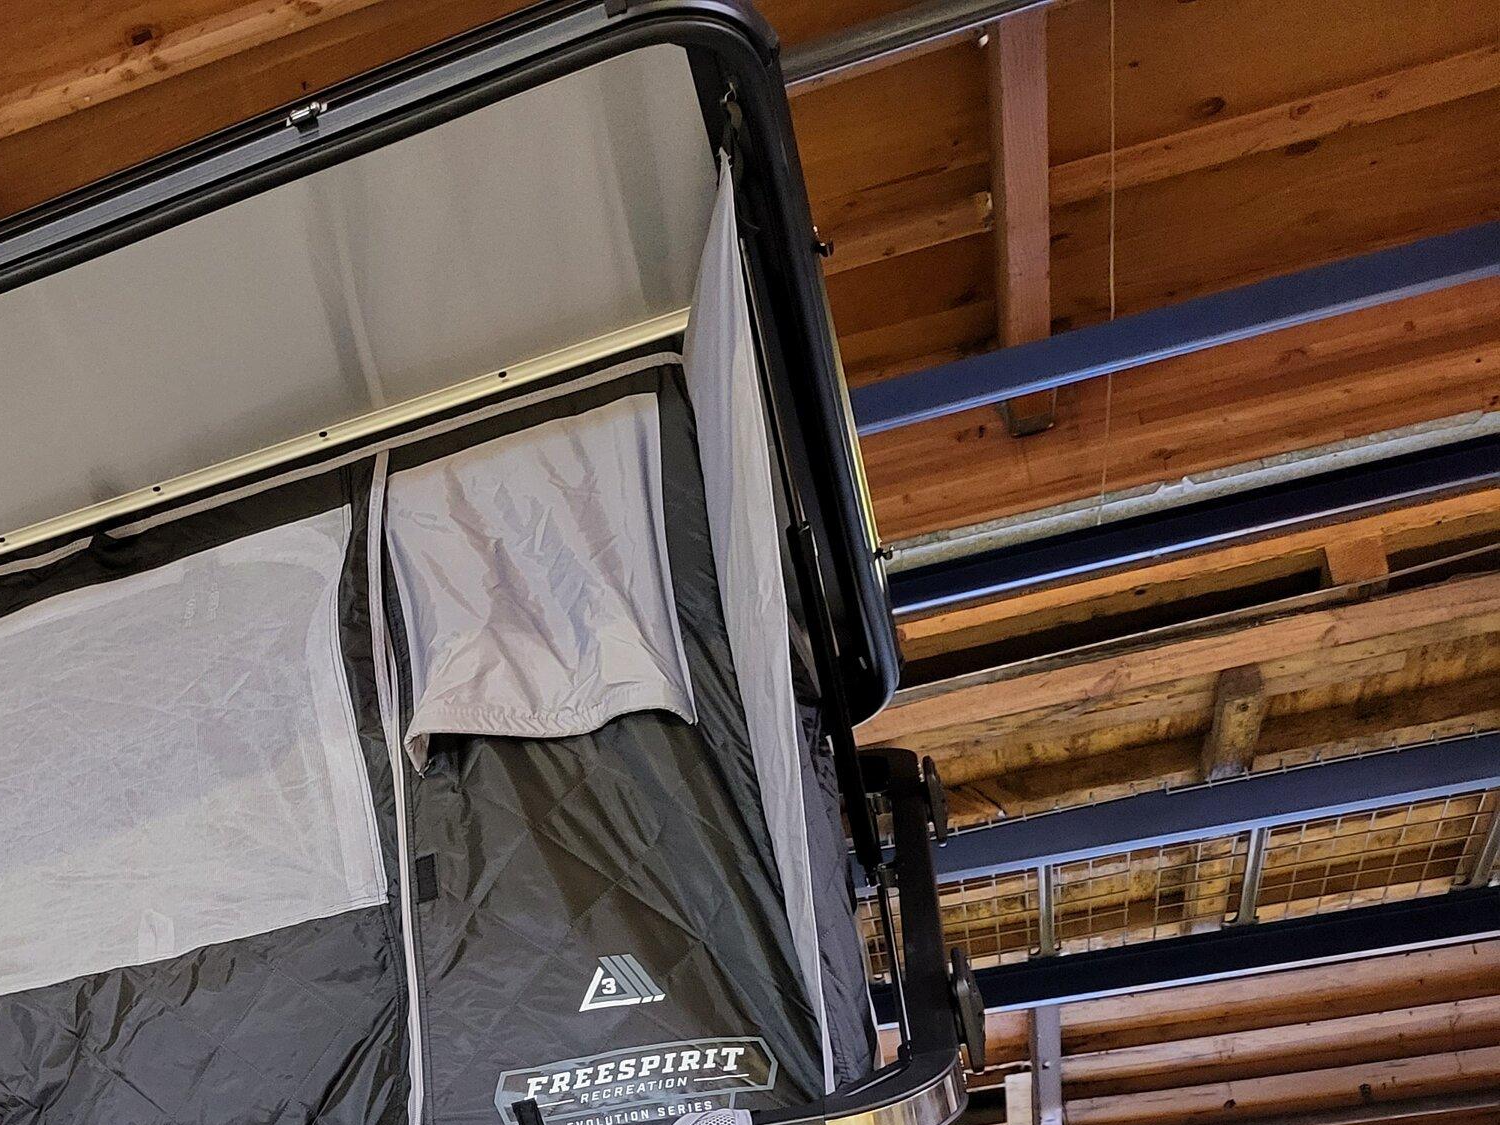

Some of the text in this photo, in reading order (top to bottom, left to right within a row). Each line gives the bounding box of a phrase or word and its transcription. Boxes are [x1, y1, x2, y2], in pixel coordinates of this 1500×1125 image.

[601, 977, 617, 995] 3
[524, 1047, 745, 1101] FREESPIRIT
[580, 1076, 688, 1104] RECREATION
[657, 1100, 714, 1118] SERIES
